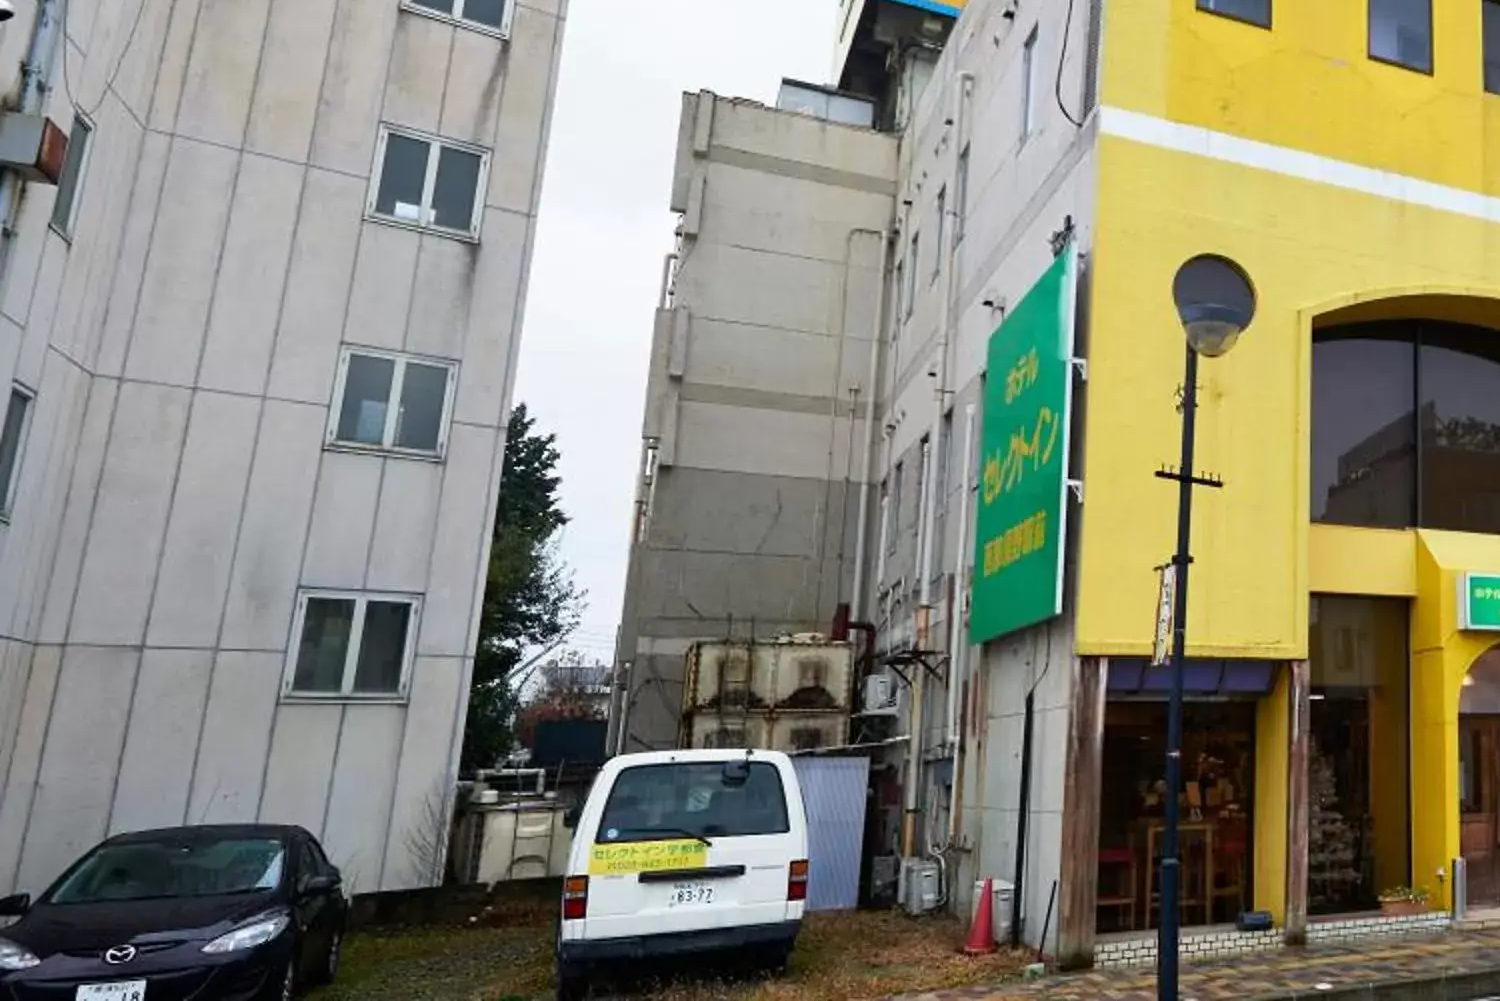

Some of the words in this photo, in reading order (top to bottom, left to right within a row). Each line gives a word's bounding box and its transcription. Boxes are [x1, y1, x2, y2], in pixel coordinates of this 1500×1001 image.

[1004, 344, 1040, 405] ホテル
[984, 406, 1060, 507] セレクトイン
